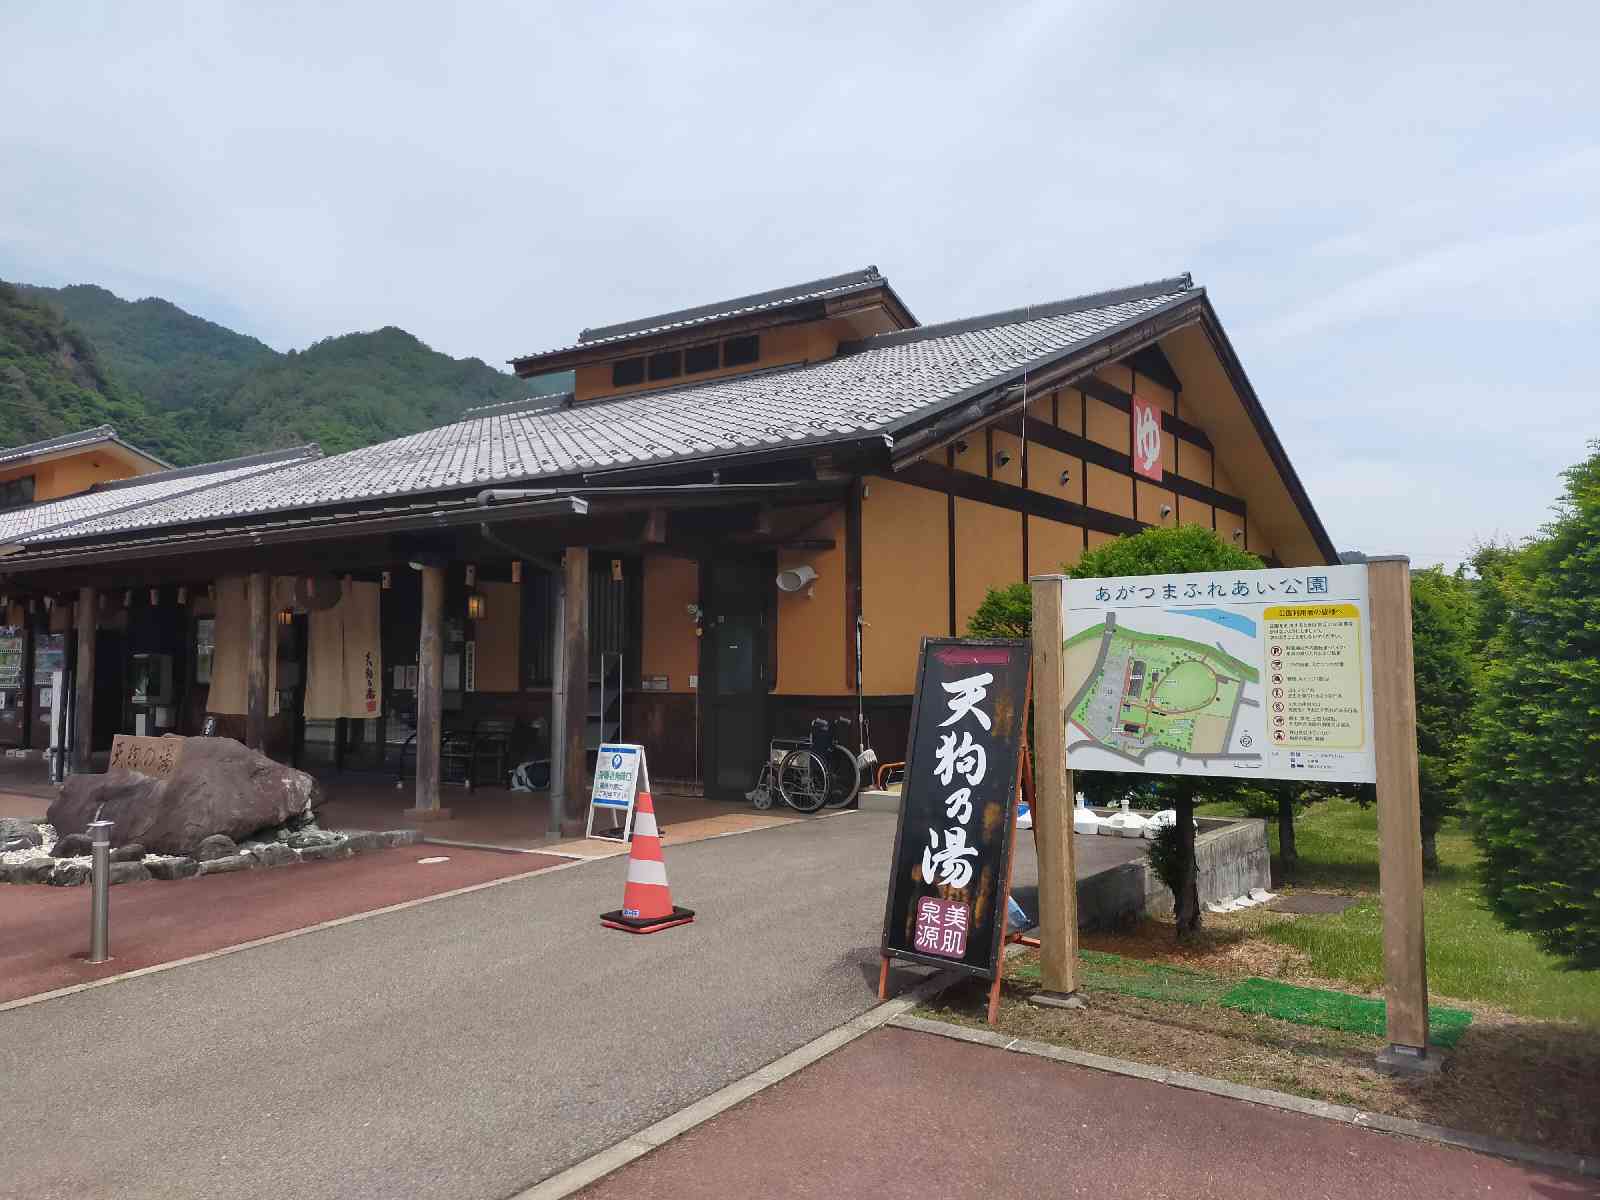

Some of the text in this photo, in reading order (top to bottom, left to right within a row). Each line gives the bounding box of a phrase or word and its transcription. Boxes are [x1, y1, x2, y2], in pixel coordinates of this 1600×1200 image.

[1135, 406, 1160, 471] ゆ
[1094, 576, 1328, 601] あがつまふれあい公園
[917, 901, 967, 955] 美肌 泉源
